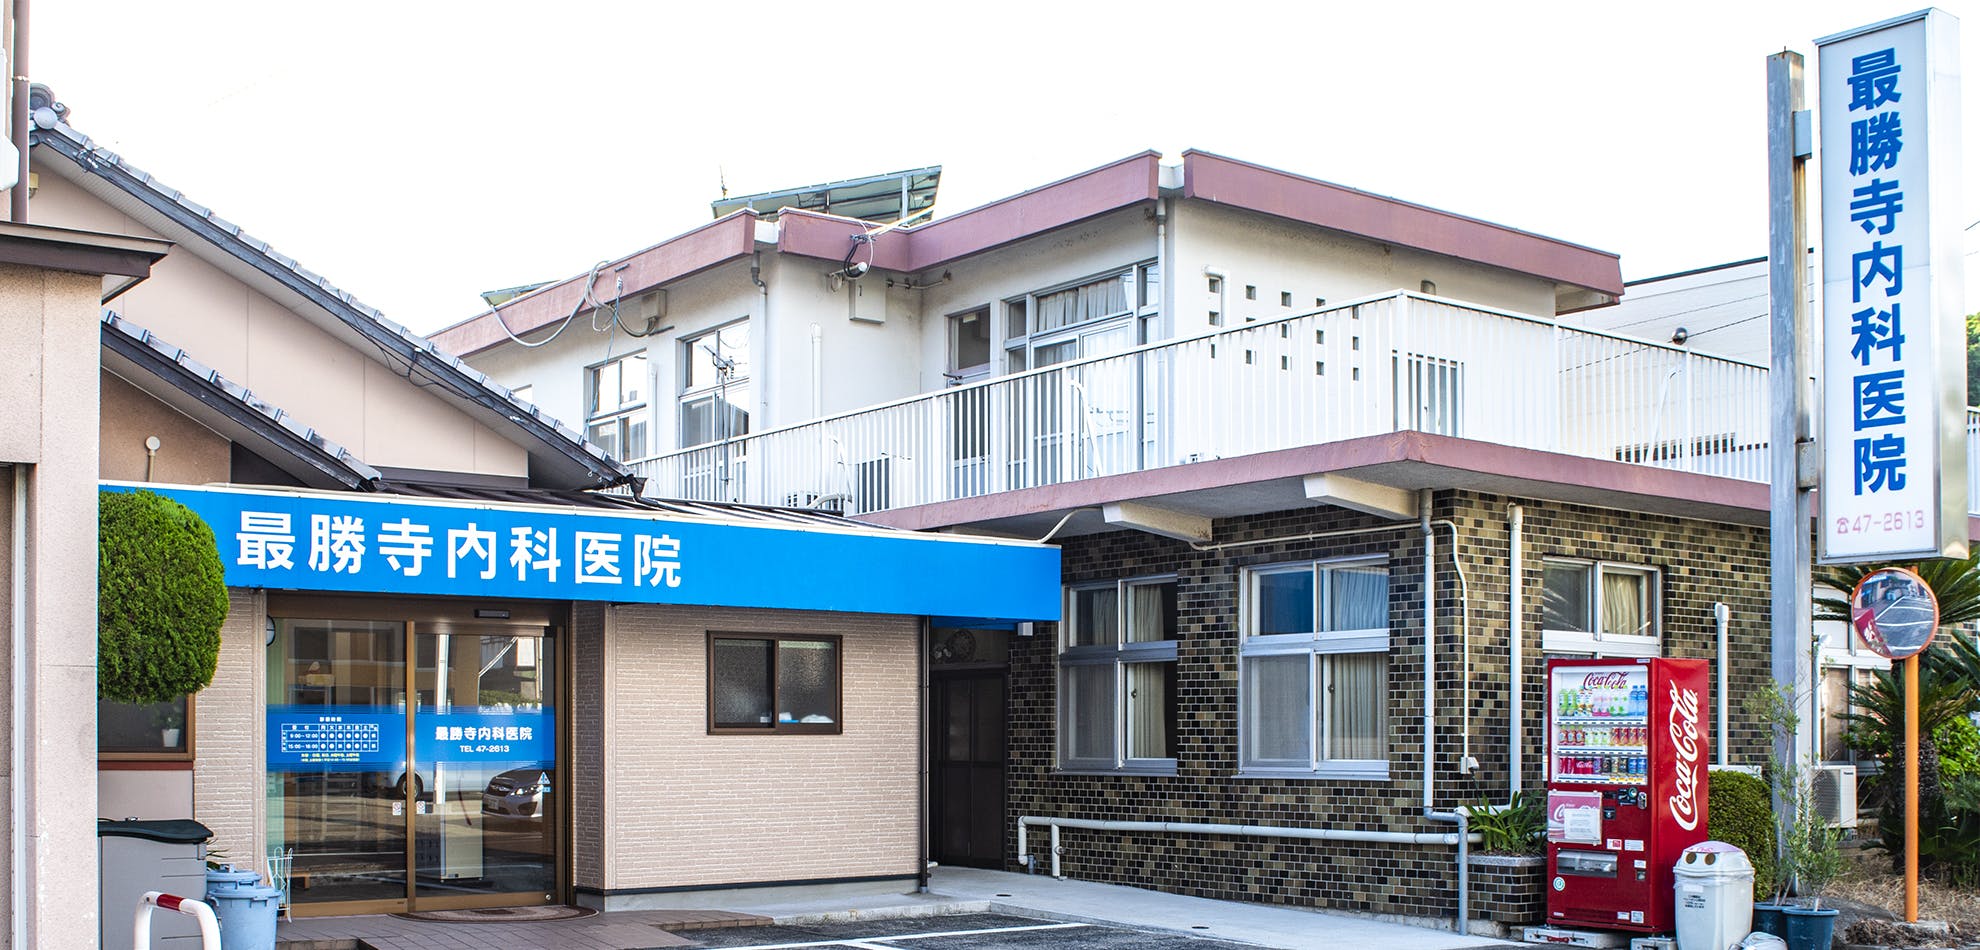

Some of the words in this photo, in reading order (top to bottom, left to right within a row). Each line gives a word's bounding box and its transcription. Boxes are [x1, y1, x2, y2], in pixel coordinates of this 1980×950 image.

[1847, 47, 1906, 496] 最勝寺内科医院
[1852, 509, 1924, 534] 47-2613
[236, 510, 682, 588] 最勝寺内科医院
[435, 726, 533, 741] 最勝寺内科医院
[460, 745, 474, 753] TEL
[476, 745, 510, 753] 47-2613
[1669, 679, 1698, 831] Coca-Cola
